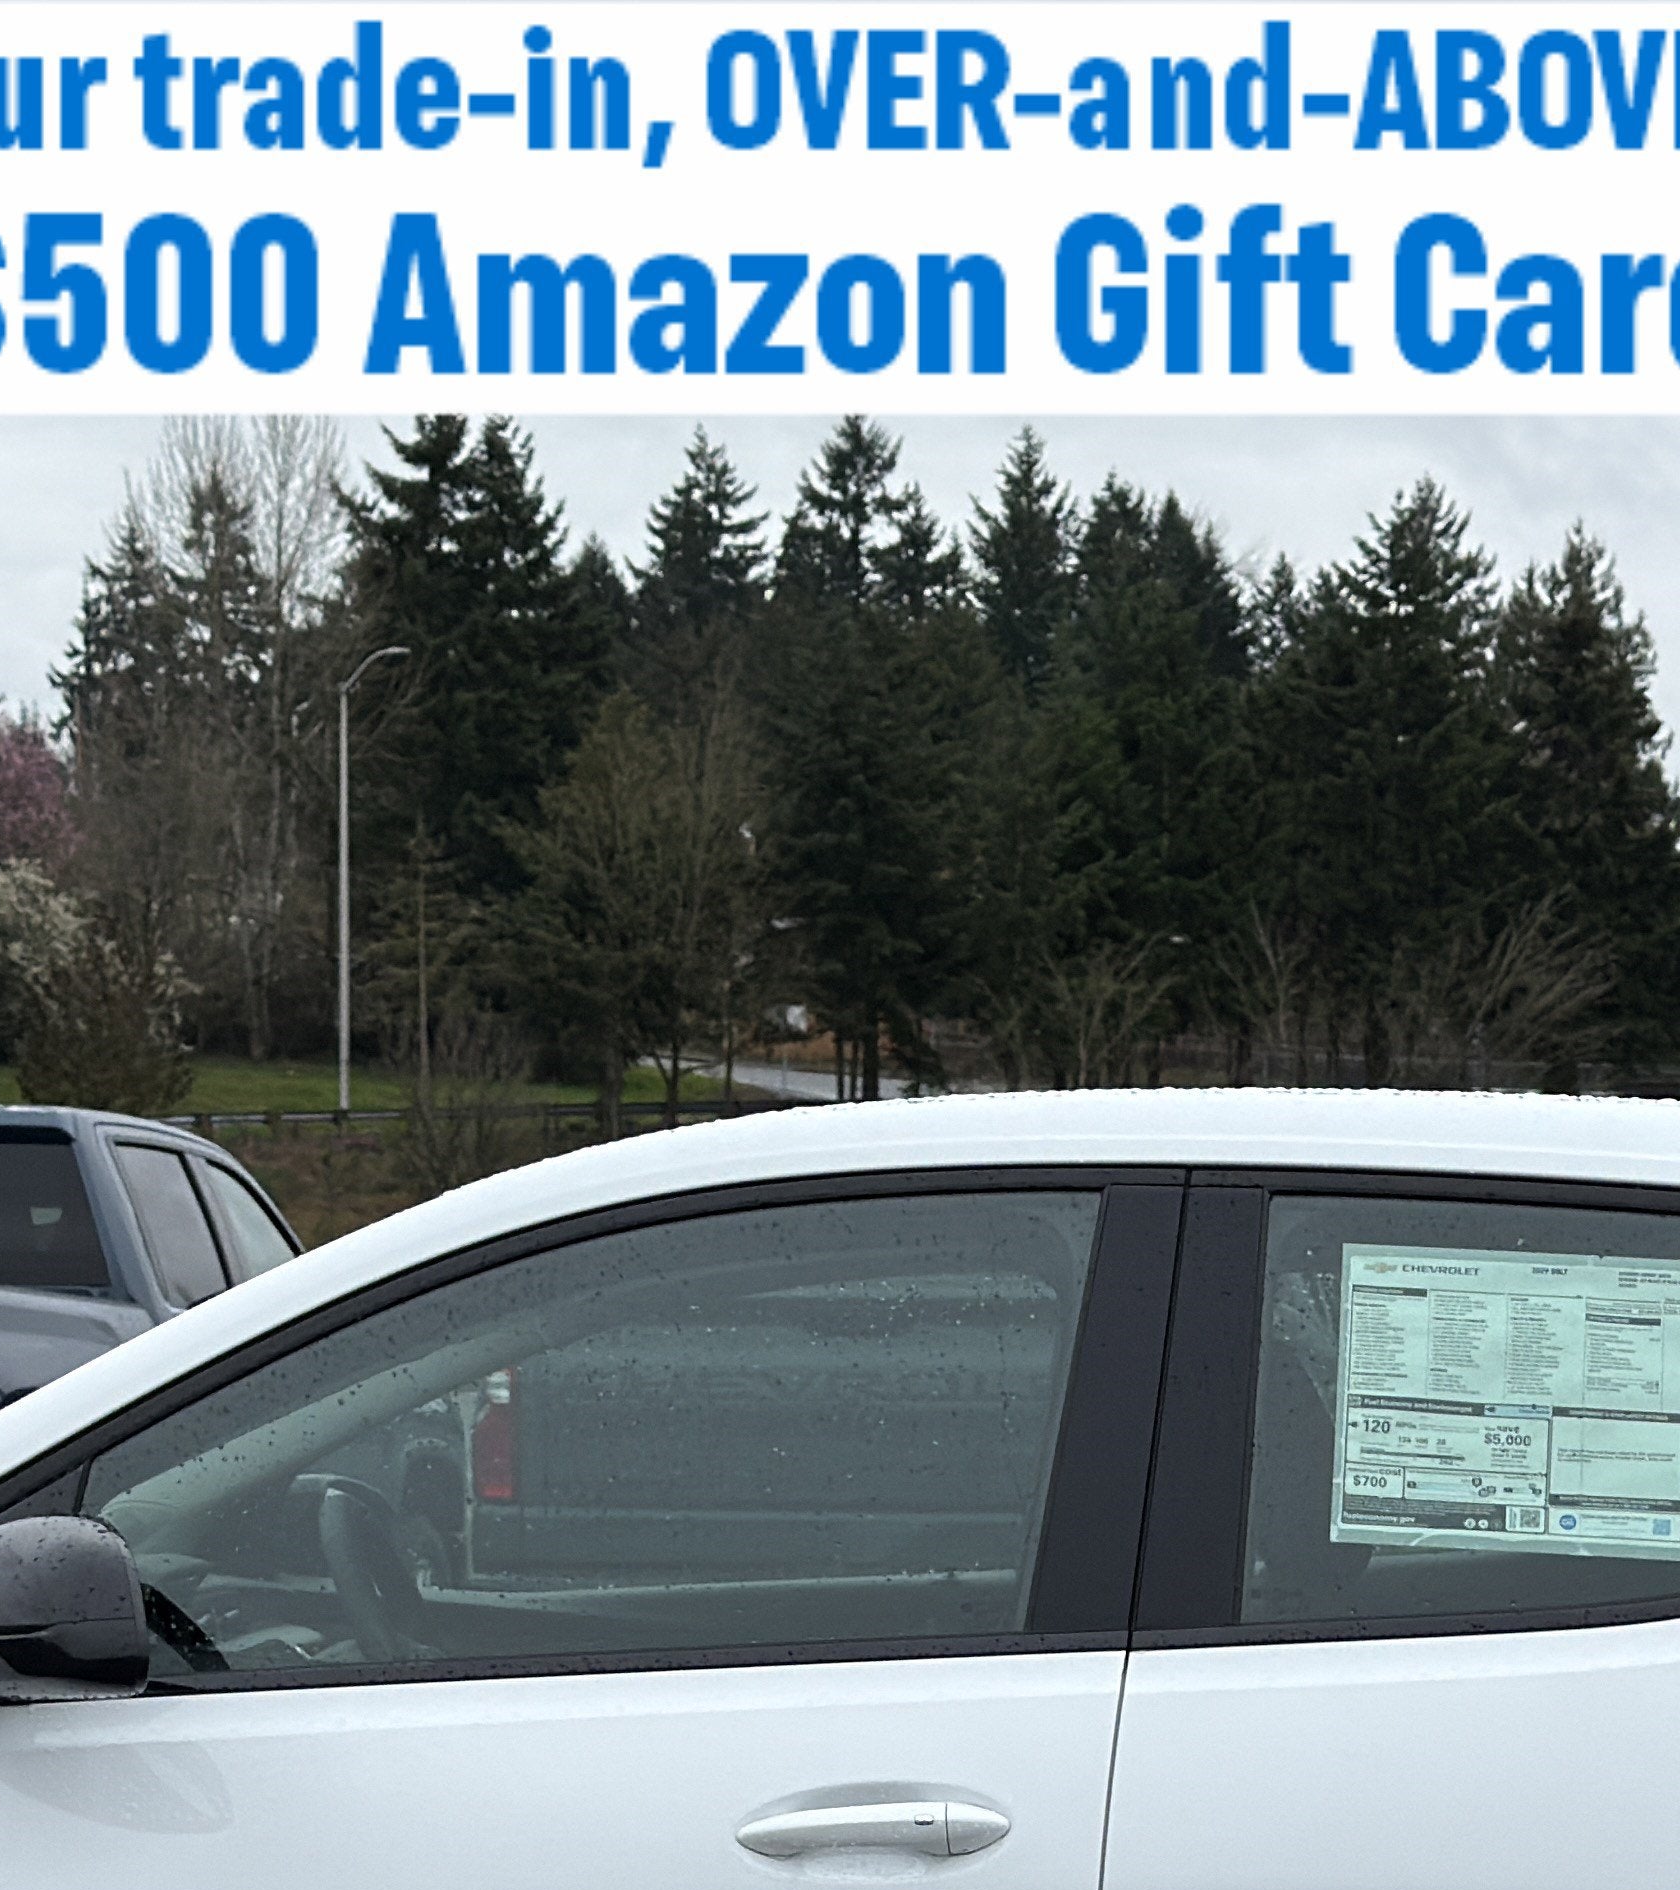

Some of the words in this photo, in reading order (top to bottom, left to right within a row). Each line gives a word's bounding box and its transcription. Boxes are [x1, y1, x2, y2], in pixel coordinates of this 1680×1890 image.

[1402, 1264, 1480, 1276] CHEVROLET
[1363, 1419, 1390, 1434] 120
[1484, 1432, 1532, 1447] $5,000
[1353, 1475, 1388, 1488] $700
